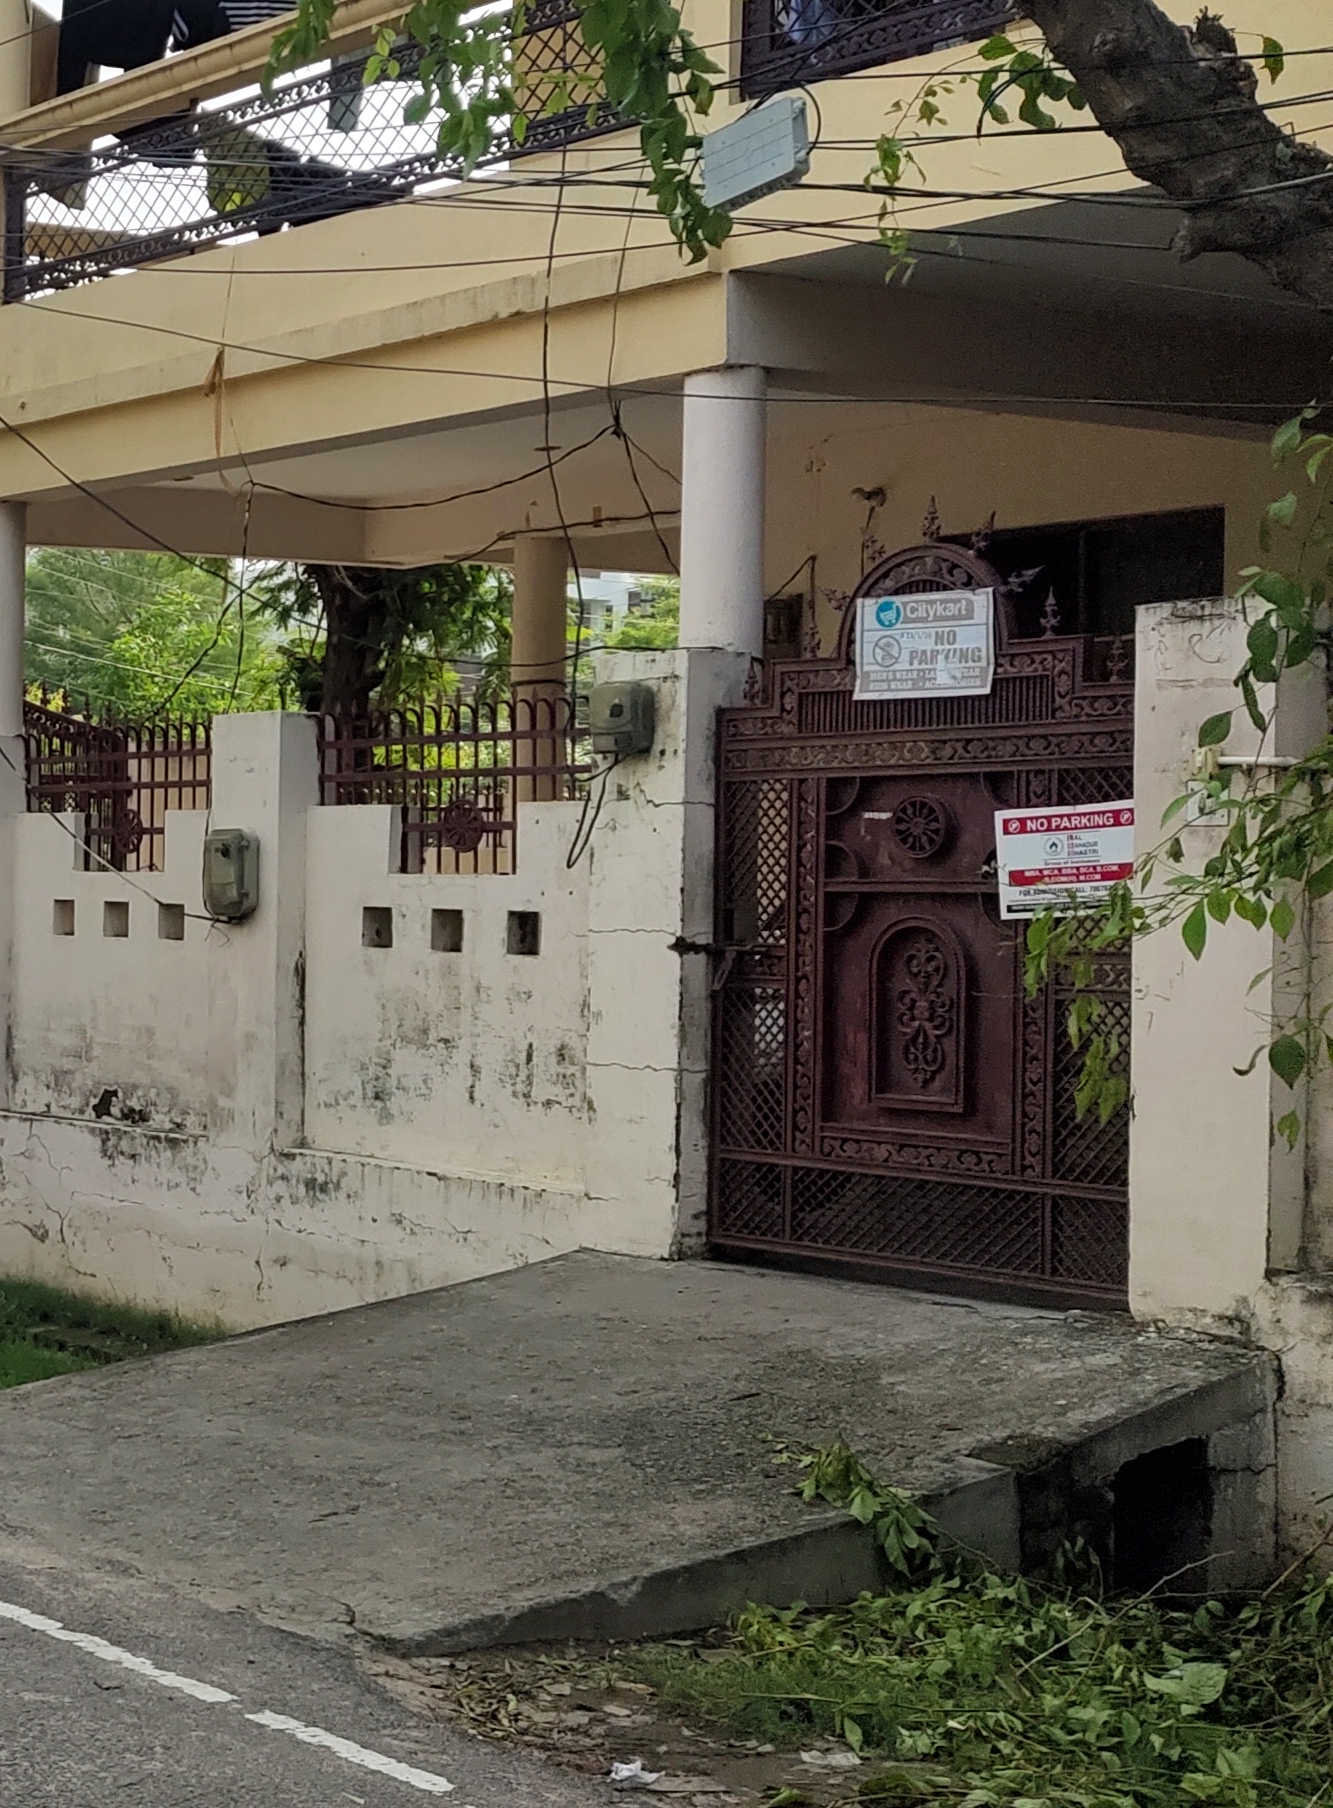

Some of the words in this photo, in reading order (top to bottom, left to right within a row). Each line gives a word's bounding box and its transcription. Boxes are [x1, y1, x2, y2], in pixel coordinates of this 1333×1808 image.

[906, 600, 967, 621] Citykart
[934, 629, 957, 647] NO
[1026, 818, 1048, 832] NO
[1051, 812, 1114, 829] PARKING
[1019, 889, 1031, 897] FOR
